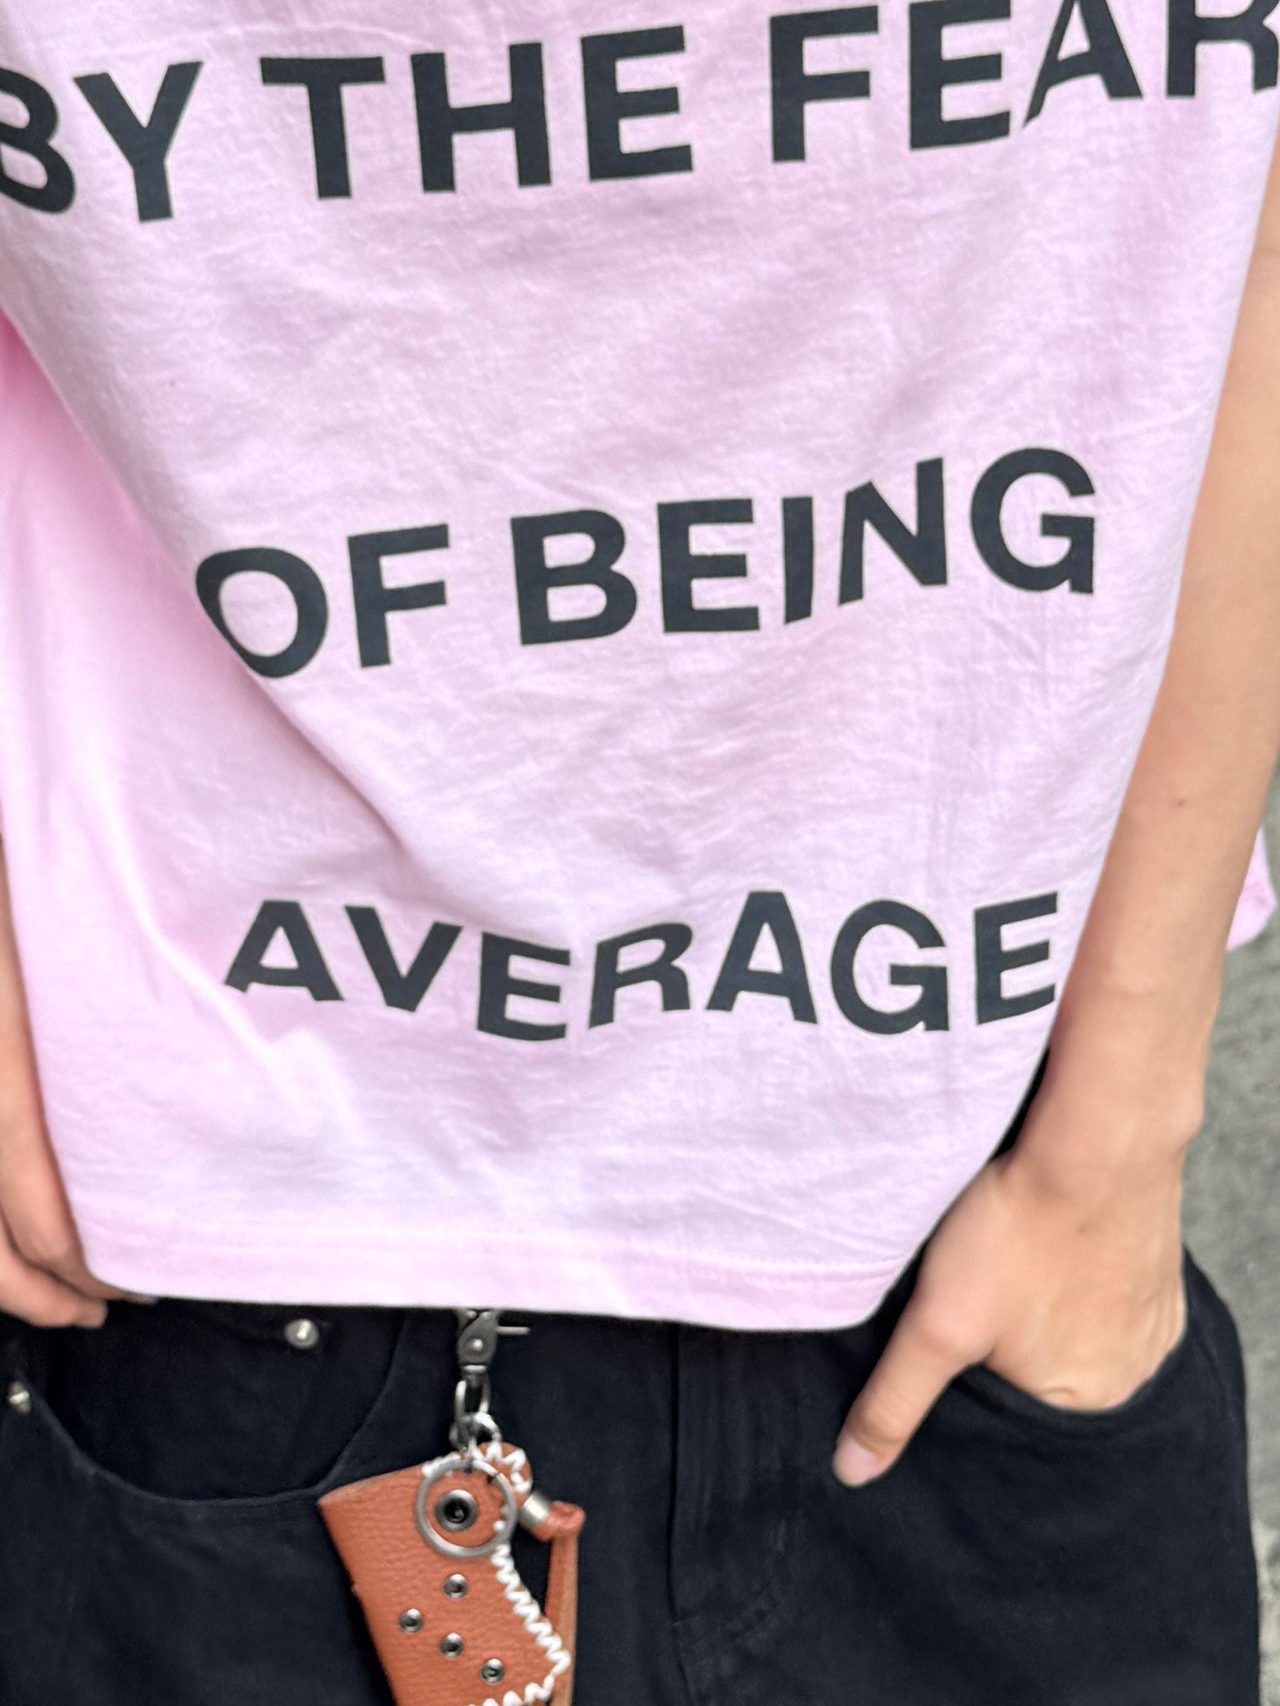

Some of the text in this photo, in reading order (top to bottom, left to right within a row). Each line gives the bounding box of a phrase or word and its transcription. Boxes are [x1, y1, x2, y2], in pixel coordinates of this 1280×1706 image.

[260, 26, 693, 199] THE
[195, 448, 1095, 679] OF BEING
[226, 892, 1058, 1036] AVERAGE
